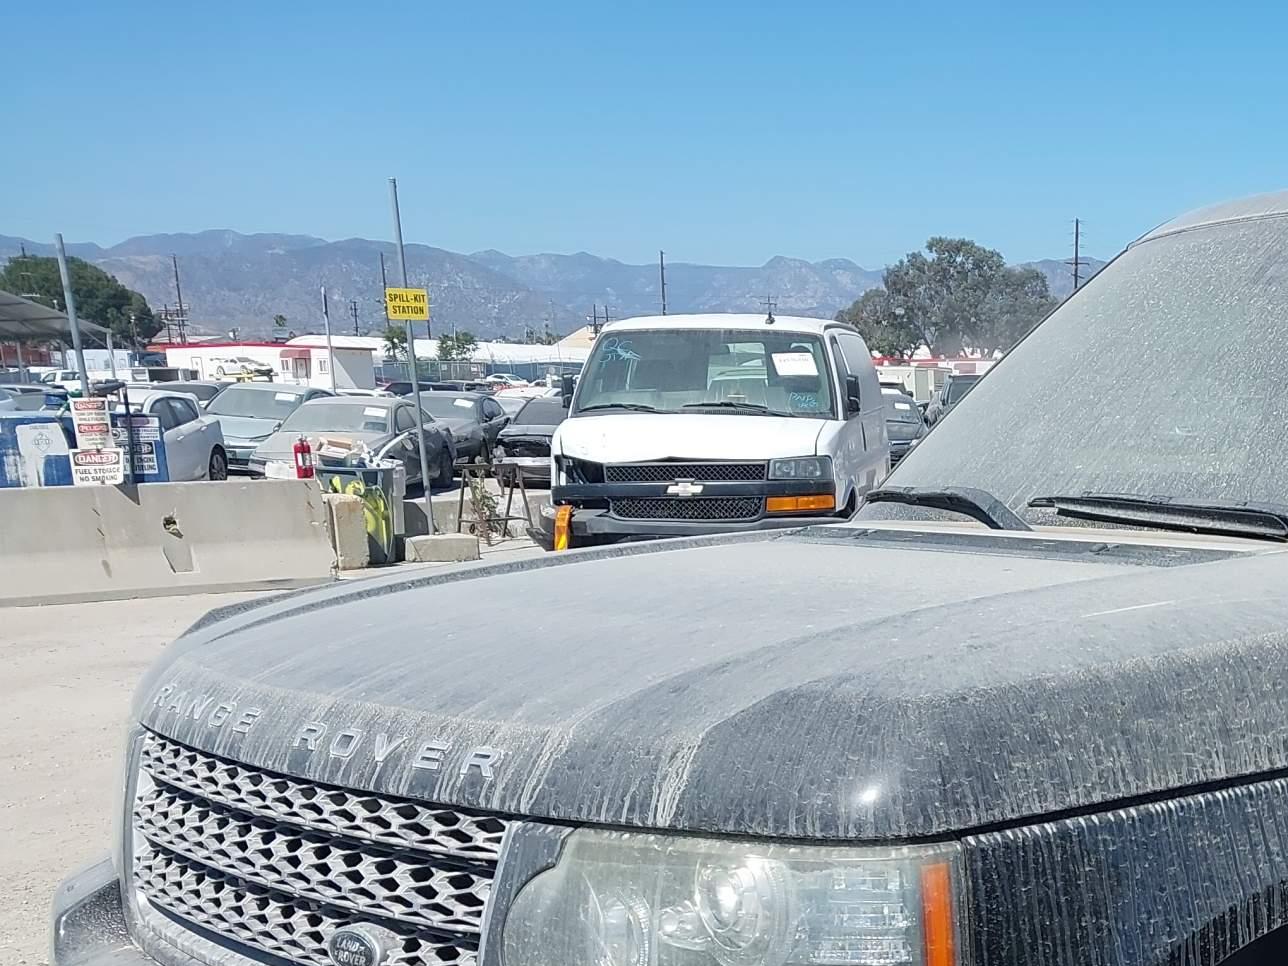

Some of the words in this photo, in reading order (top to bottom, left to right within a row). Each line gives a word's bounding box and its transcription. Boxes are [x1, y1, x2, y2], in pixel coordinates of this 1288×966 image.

[388, 293, 426, 303] SPILL-KIT
[392, 305, 425, 315] STATION
[78, 454, 117, 464] DANGER
[75, 467, 93, 475] FUEL
[94, 466, 121, 475] STORAGE
[152, 683, 263, 735] RANGE
[293, 722, 504, 780] ROVER
[336, 936, 360, 952] LAND
